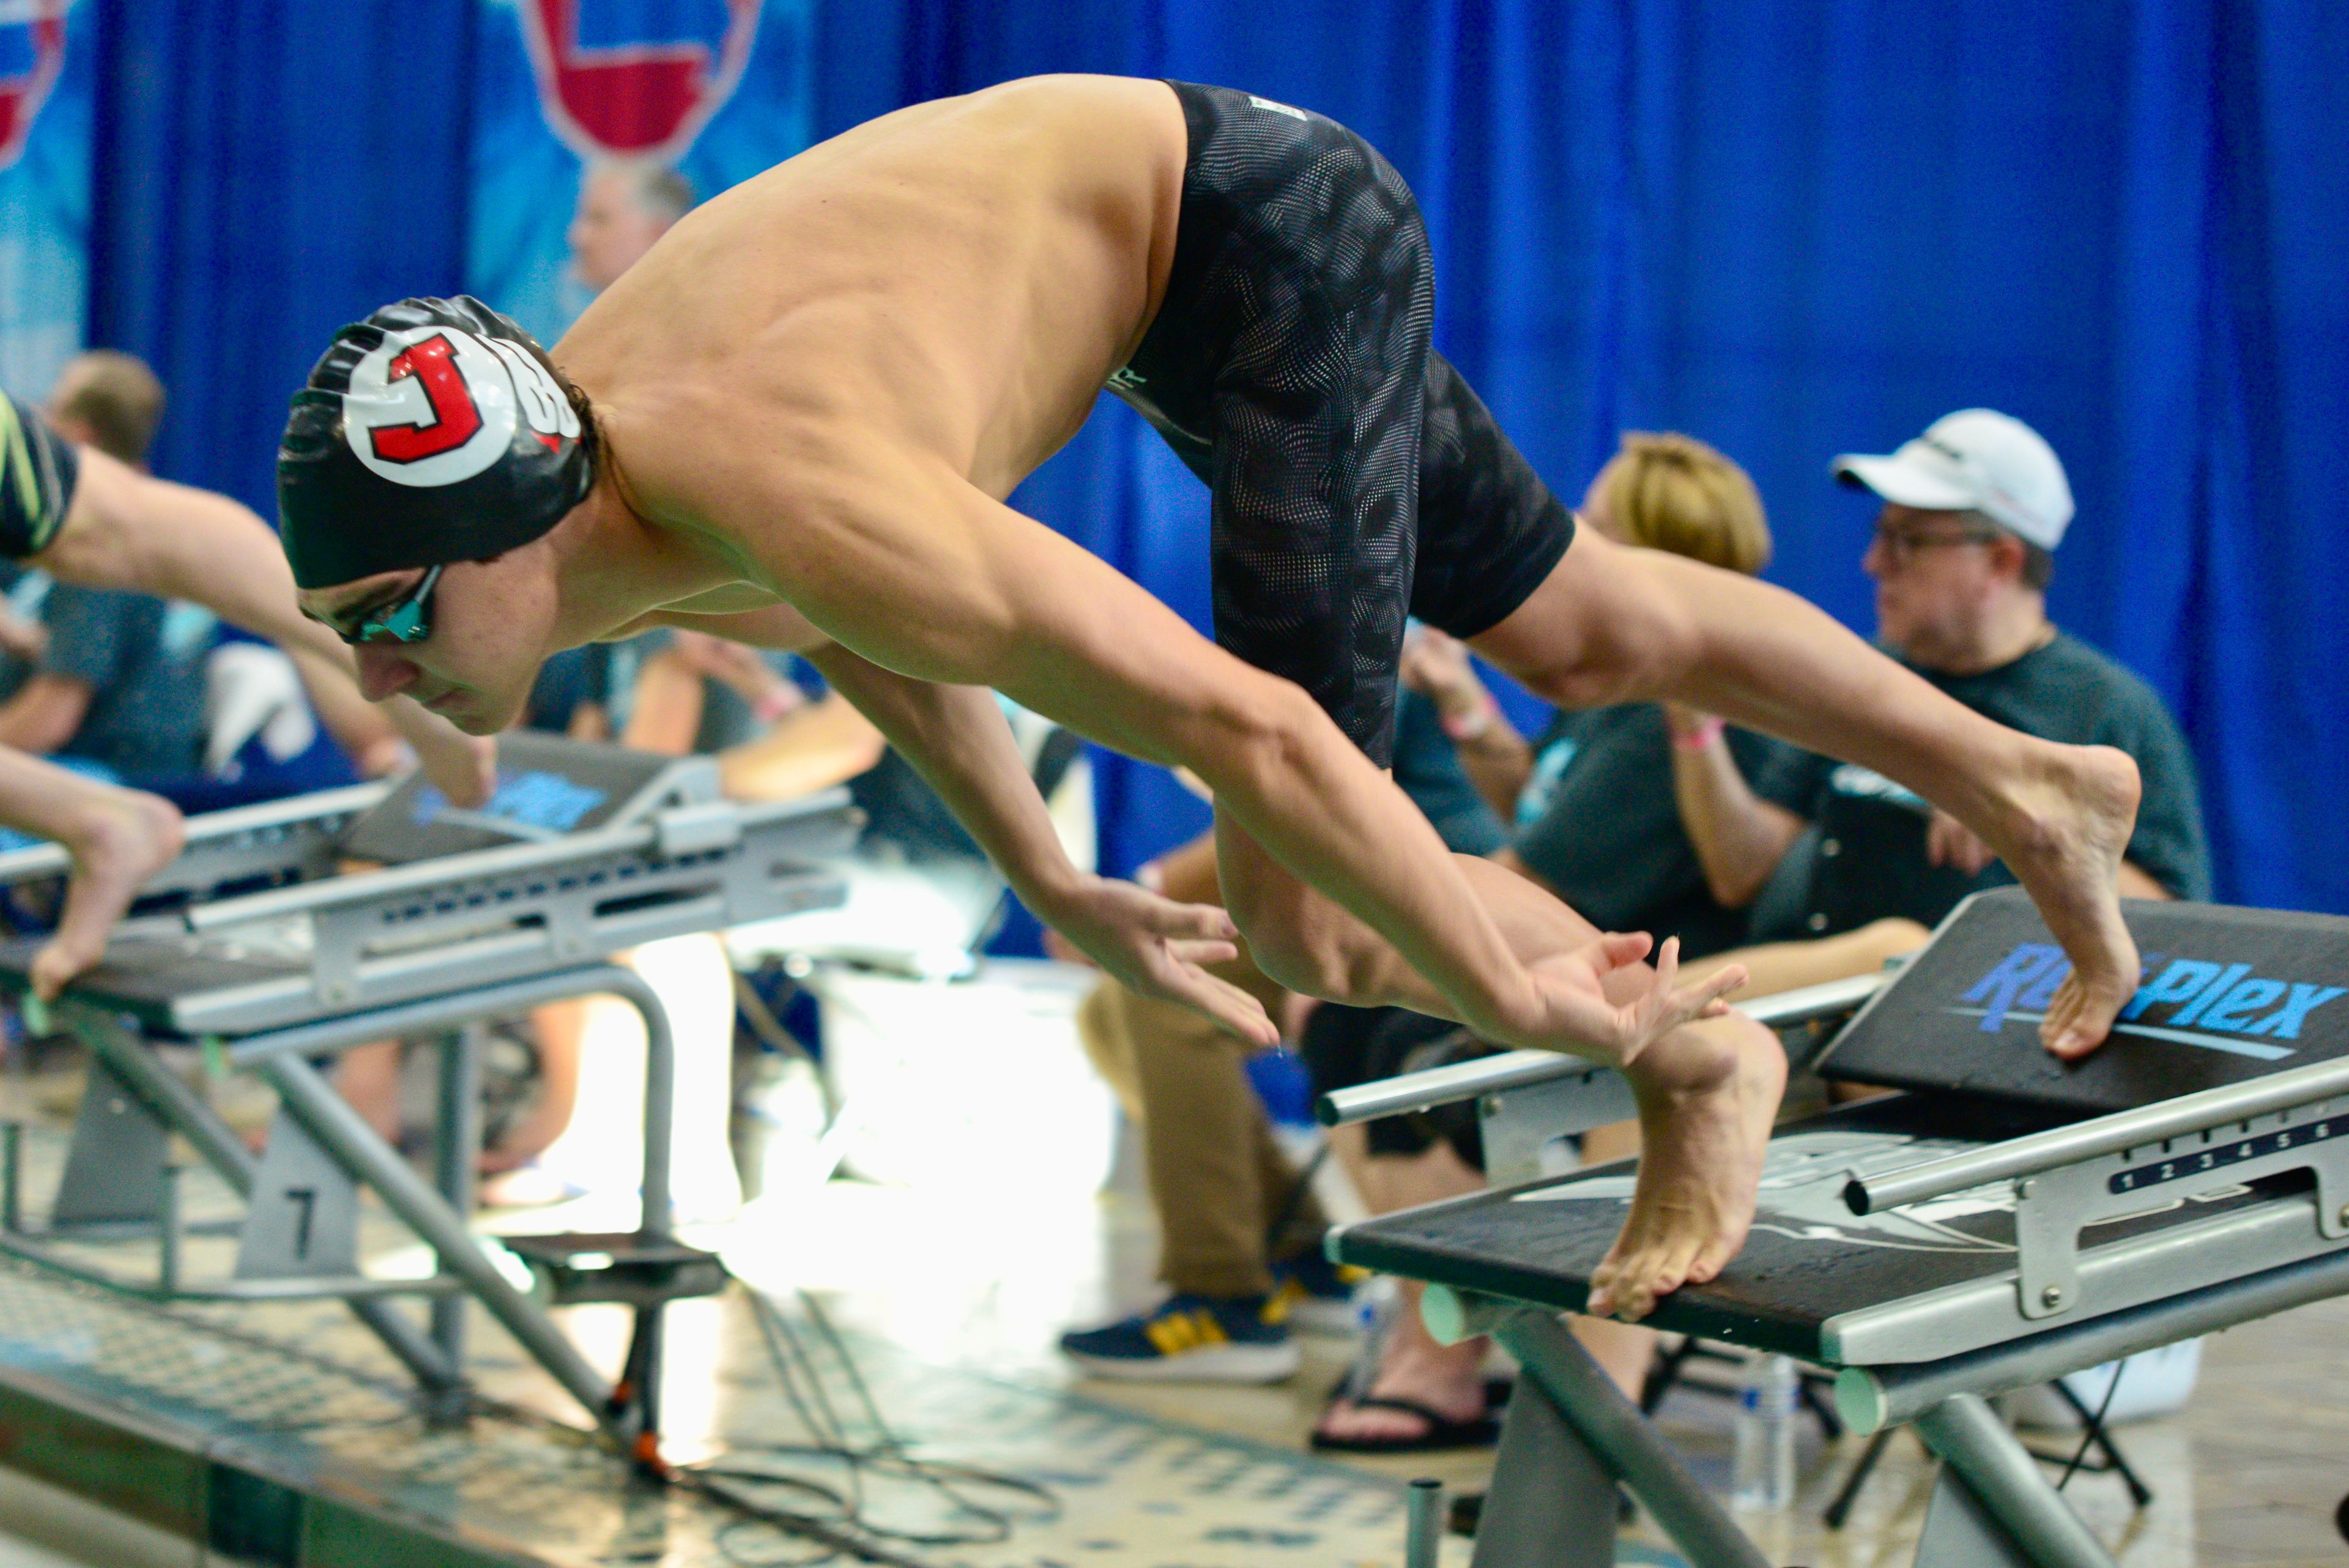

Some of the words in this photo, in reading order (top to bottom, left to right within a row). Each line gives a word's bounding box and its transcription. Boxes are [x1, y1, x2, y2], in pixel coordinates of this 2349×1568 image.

[368, 332, 484, 465] J
[2121, 1173, 2134, 1189] 1
[2161, 1164, 2175, 1180] 2
[2200, 1153, 2213, 1168] 3
[2238, 1143, 2252, 1157] 4
[2276, 1132, 2291, 1148] 5
[2315, 1123, 2329, 1139] 6
[284, 1188, 316, 1261] 7
